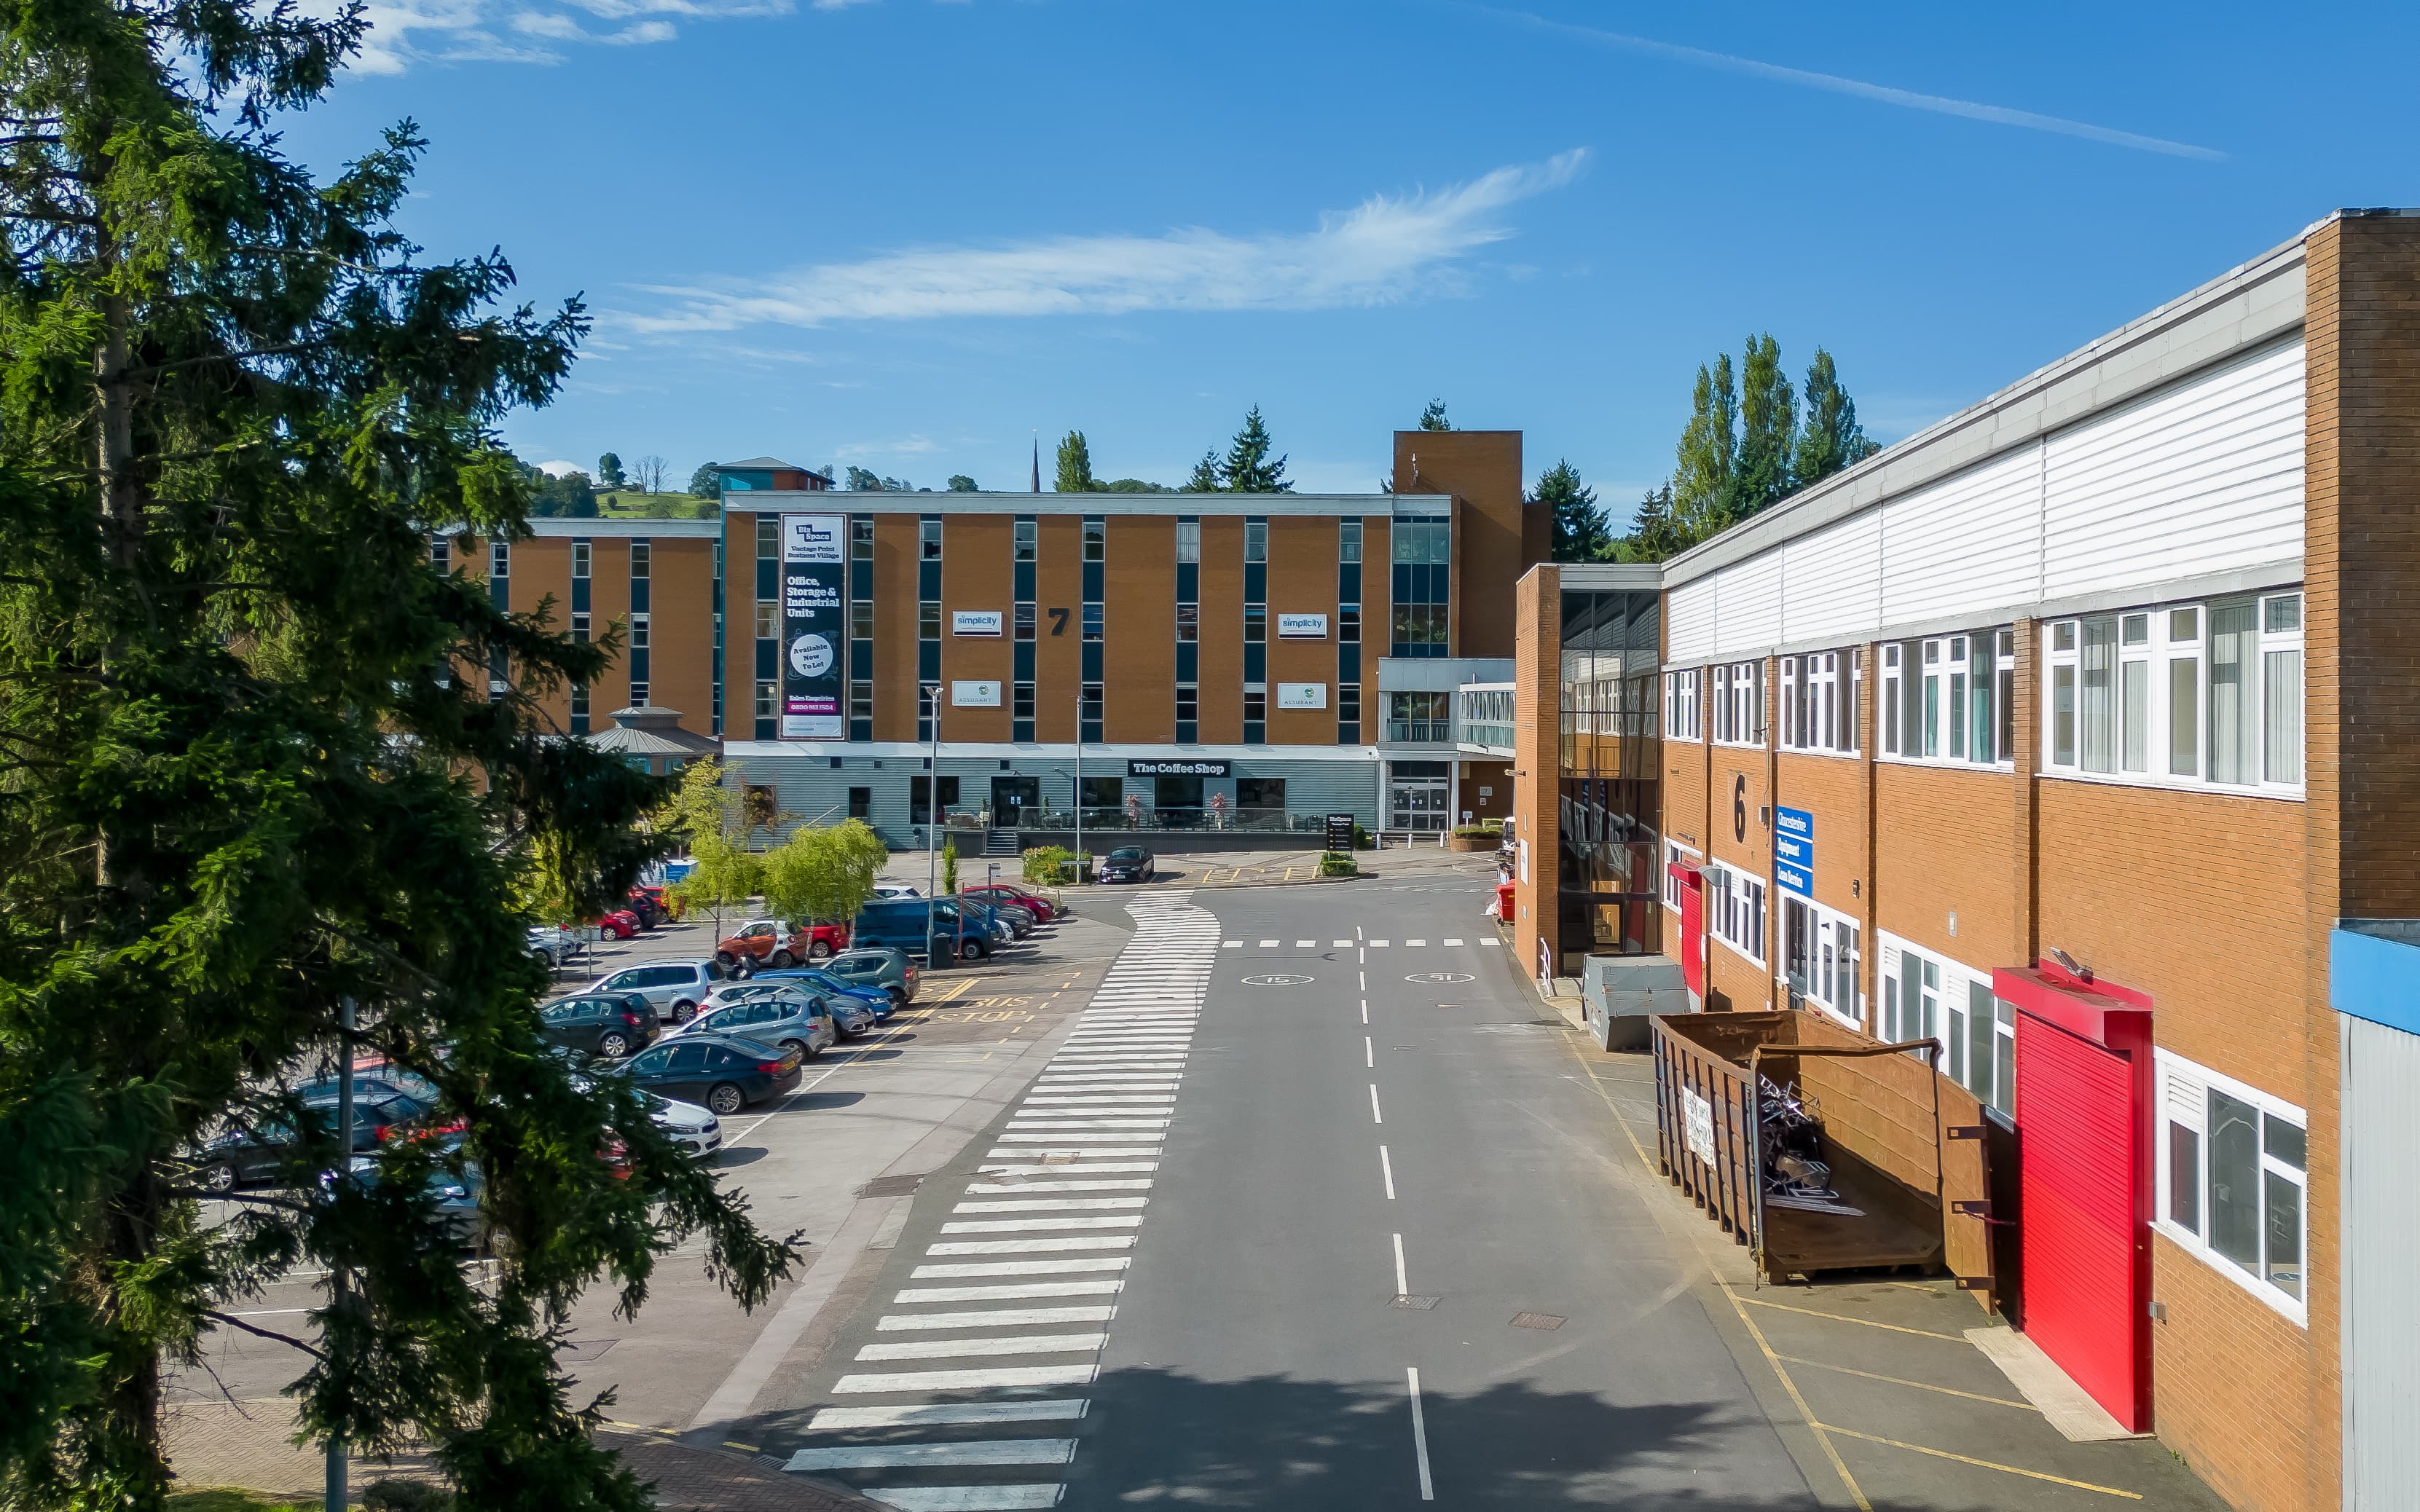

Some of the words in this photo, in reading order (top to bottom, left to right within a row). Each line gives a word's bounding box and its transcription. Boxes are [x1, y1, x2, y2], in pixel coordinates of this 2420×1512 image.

[787, 576, 820, 586] Office,
[787, 587, 827, 597] Storage
[828, 587, 836, 596] &
[787, 597, 840, 607] Industrial
[787, 608, 815, 617] Units
[957, 615, 997, 626] simplicity
[1048, 608, 1069, 636] 7
[1282, 618, 1322, 629] simplicity
[793, 644, 828, 654] Available
[1134, 763, 1157, 773] The
[1158, 763, 1194, 773] Coffee
[1195, 763, 1225, 775] Shop
[1735, 774, 1745, 843] 6
[960, 996, 1034, 1009] BUS
[937, 1009, 1028, 1023] STOP
